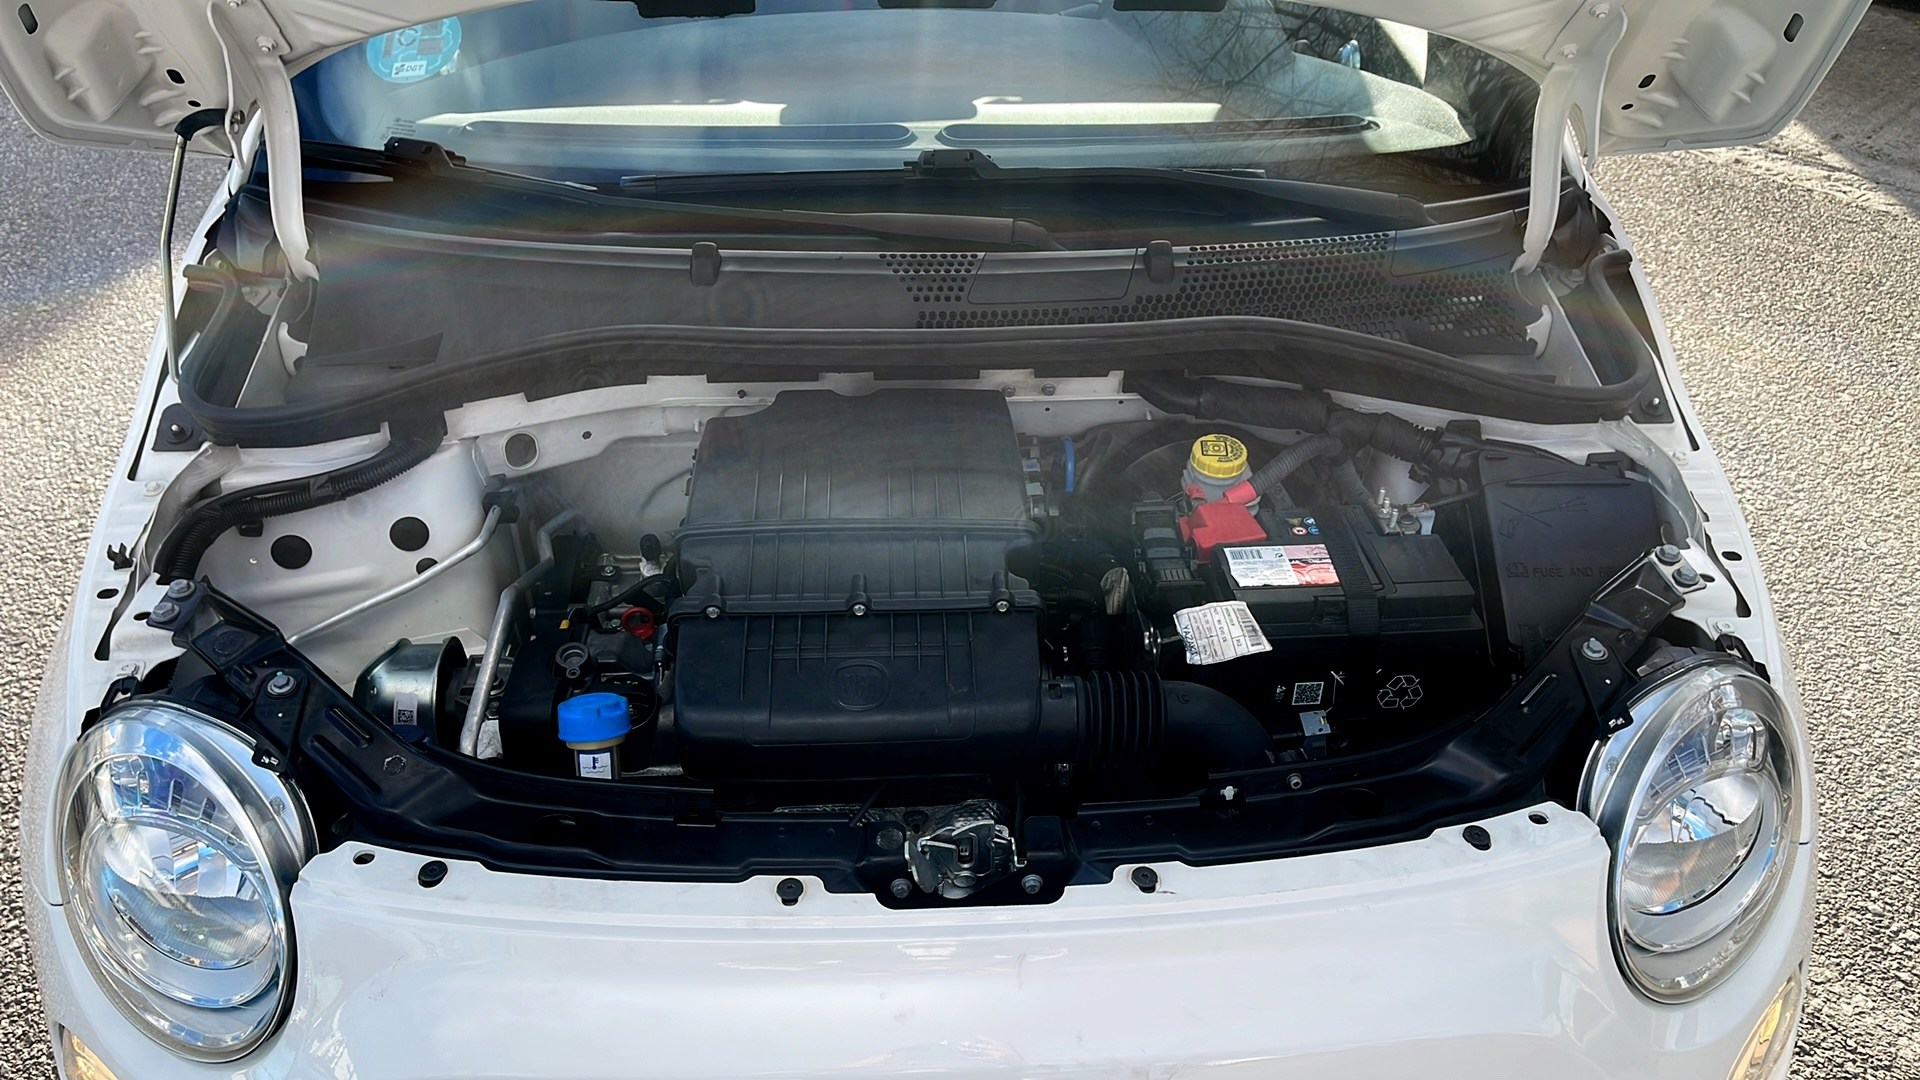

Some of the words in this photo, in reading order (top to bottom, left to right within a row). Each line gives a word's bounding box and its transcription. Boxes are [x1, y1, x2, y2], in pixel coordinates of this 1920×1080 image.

[405, 64, 424, 72] DGT
[1533, 567, 1563, 578] FUSE
[1569, 566, 1594, 577] AND
